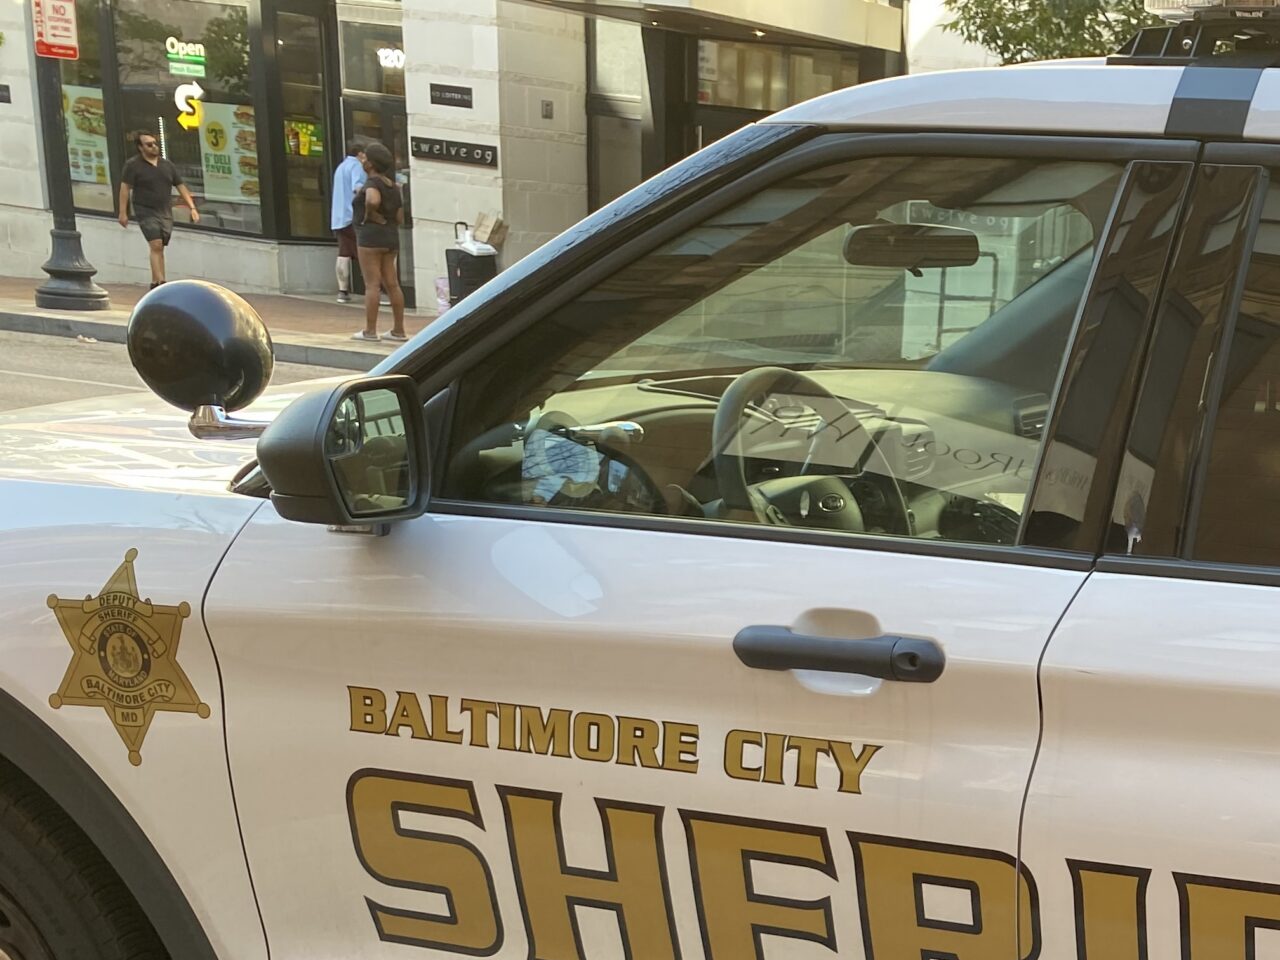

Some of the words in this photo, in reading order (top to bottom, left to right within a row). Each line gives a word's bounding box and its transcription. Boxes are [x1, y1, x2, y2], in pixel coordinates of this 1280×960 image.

[52, 5, 66, 16] NO
[166, 36, 205, 59] Open
[411, 141, 468, 157] twelve
[214, 154, 231, 165] DELI
[99, 594, 138, 609] DEPUTY
[97, 608, 138, 623] SHERIFF
[85, 678, 145, 704] BALTIMORE
[147, 682, 171, 698] CITY
[120, 711, 138, 723] MD
[347, 685, 700, 774] BALTIMORE
[723, 728, 884, 795] CITY
